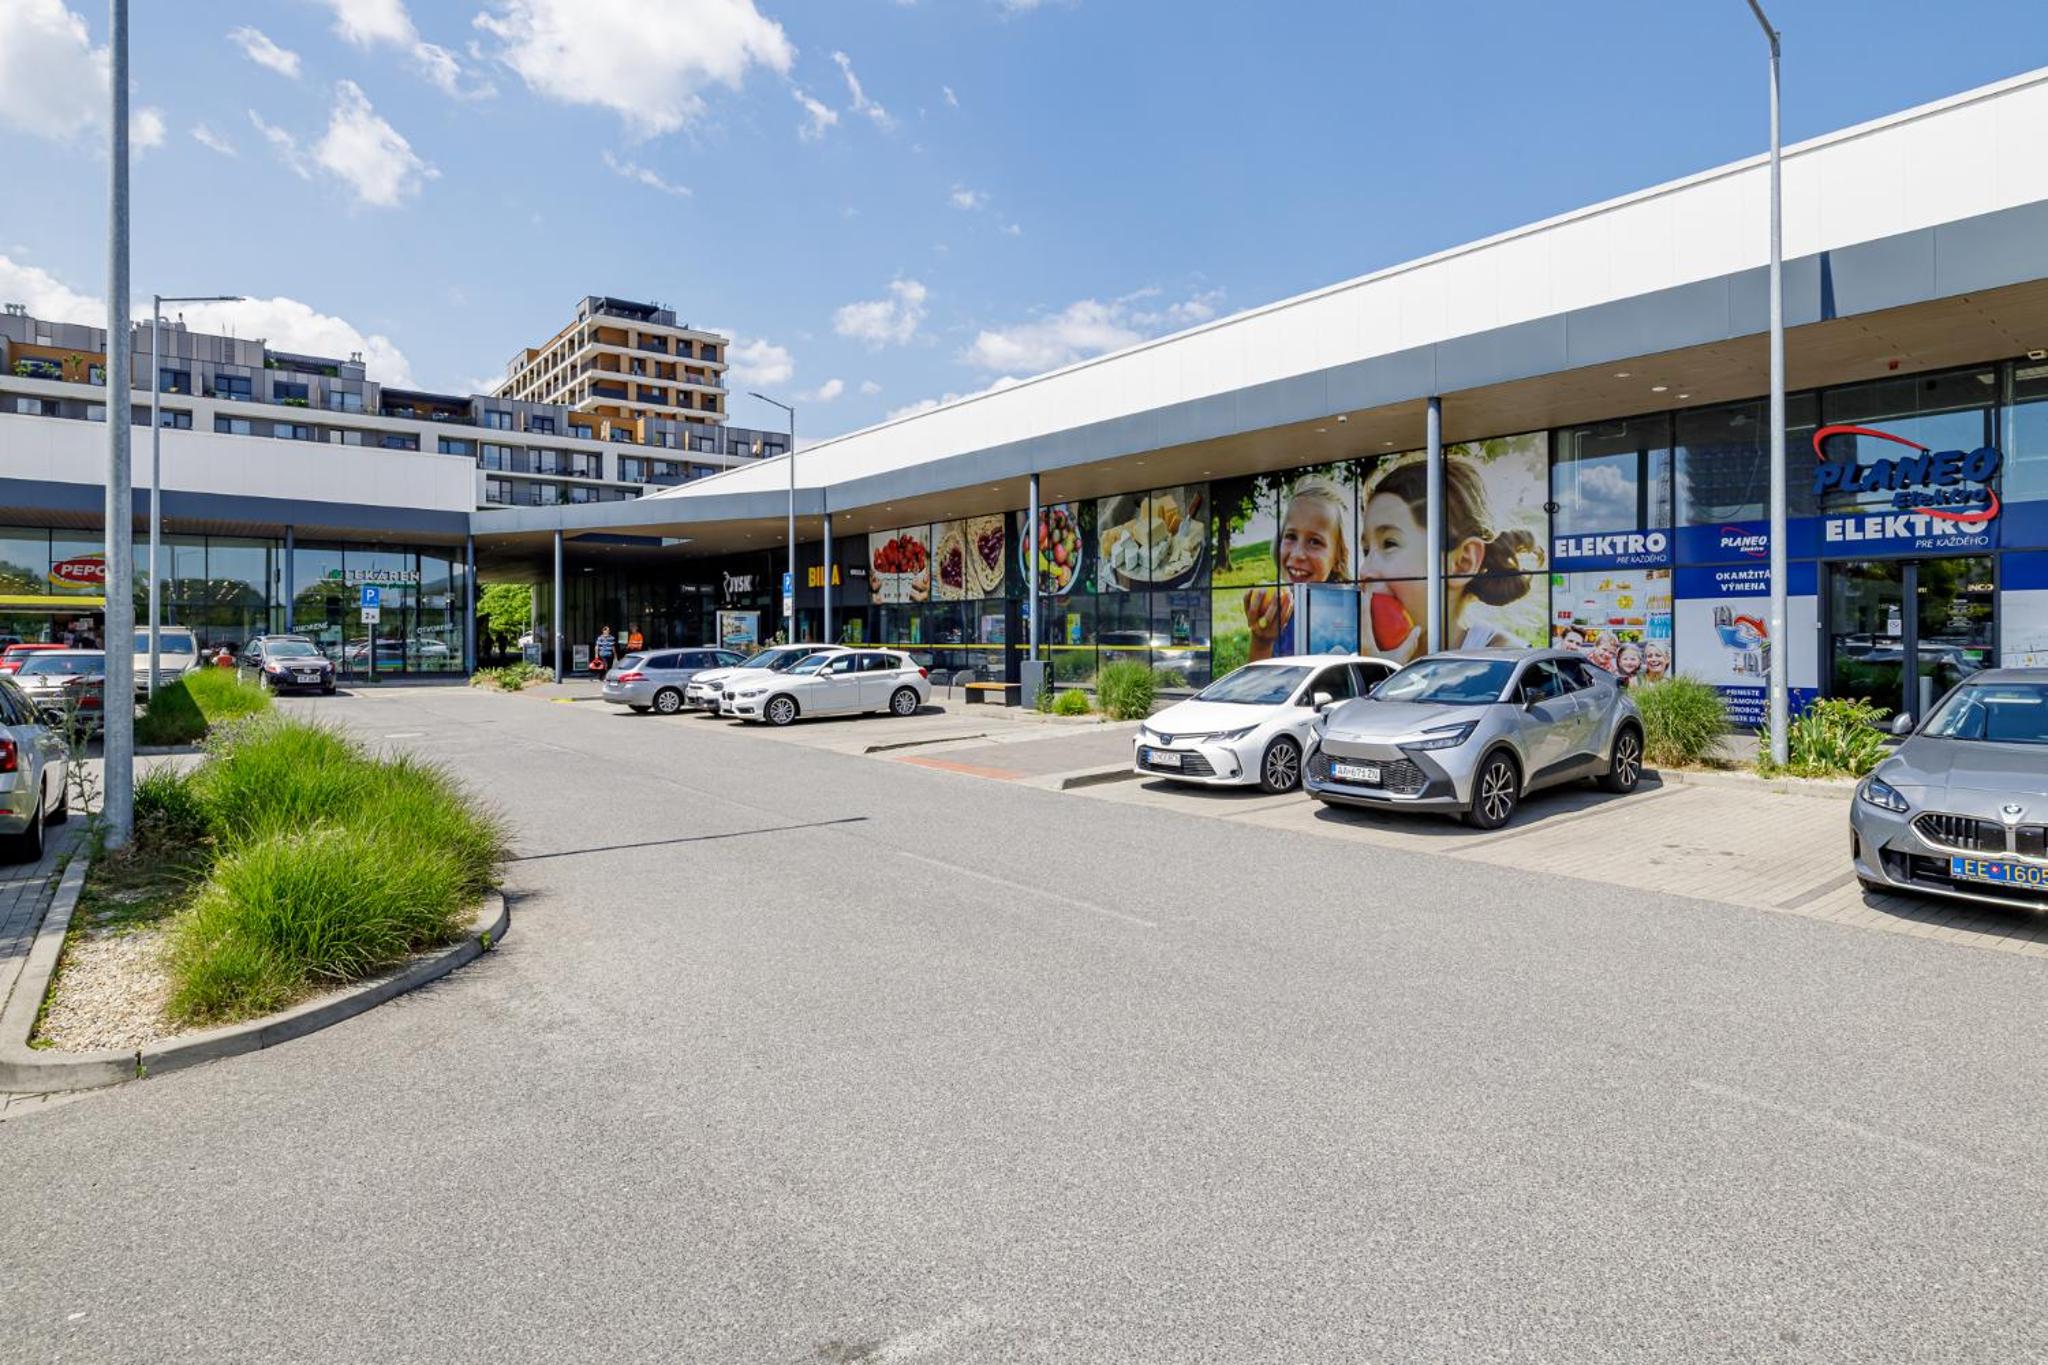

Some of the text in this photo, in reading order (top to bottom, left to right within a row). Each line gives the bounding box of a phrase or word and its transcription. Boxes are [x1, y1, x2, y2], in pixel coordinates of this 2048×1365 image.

[1813, 447, 2003, 495] PLANEO
[1826, 510, 1991, 542] ELEKTRO
[1554, 532, 1667, 558] ELEKTRO
[1720, 536, 1768, 548] PLANEO
[1915, 535, 1989, 549] PRE KAŽDÉHO
[61, 564, 106, 576] PEPC
[729, 575, 753, 592] JYSK
[1721, 581, 1766, 591] VÝMENA
[367, 589, 375, 601] P
[1965, 859, 1991, 877] EE
